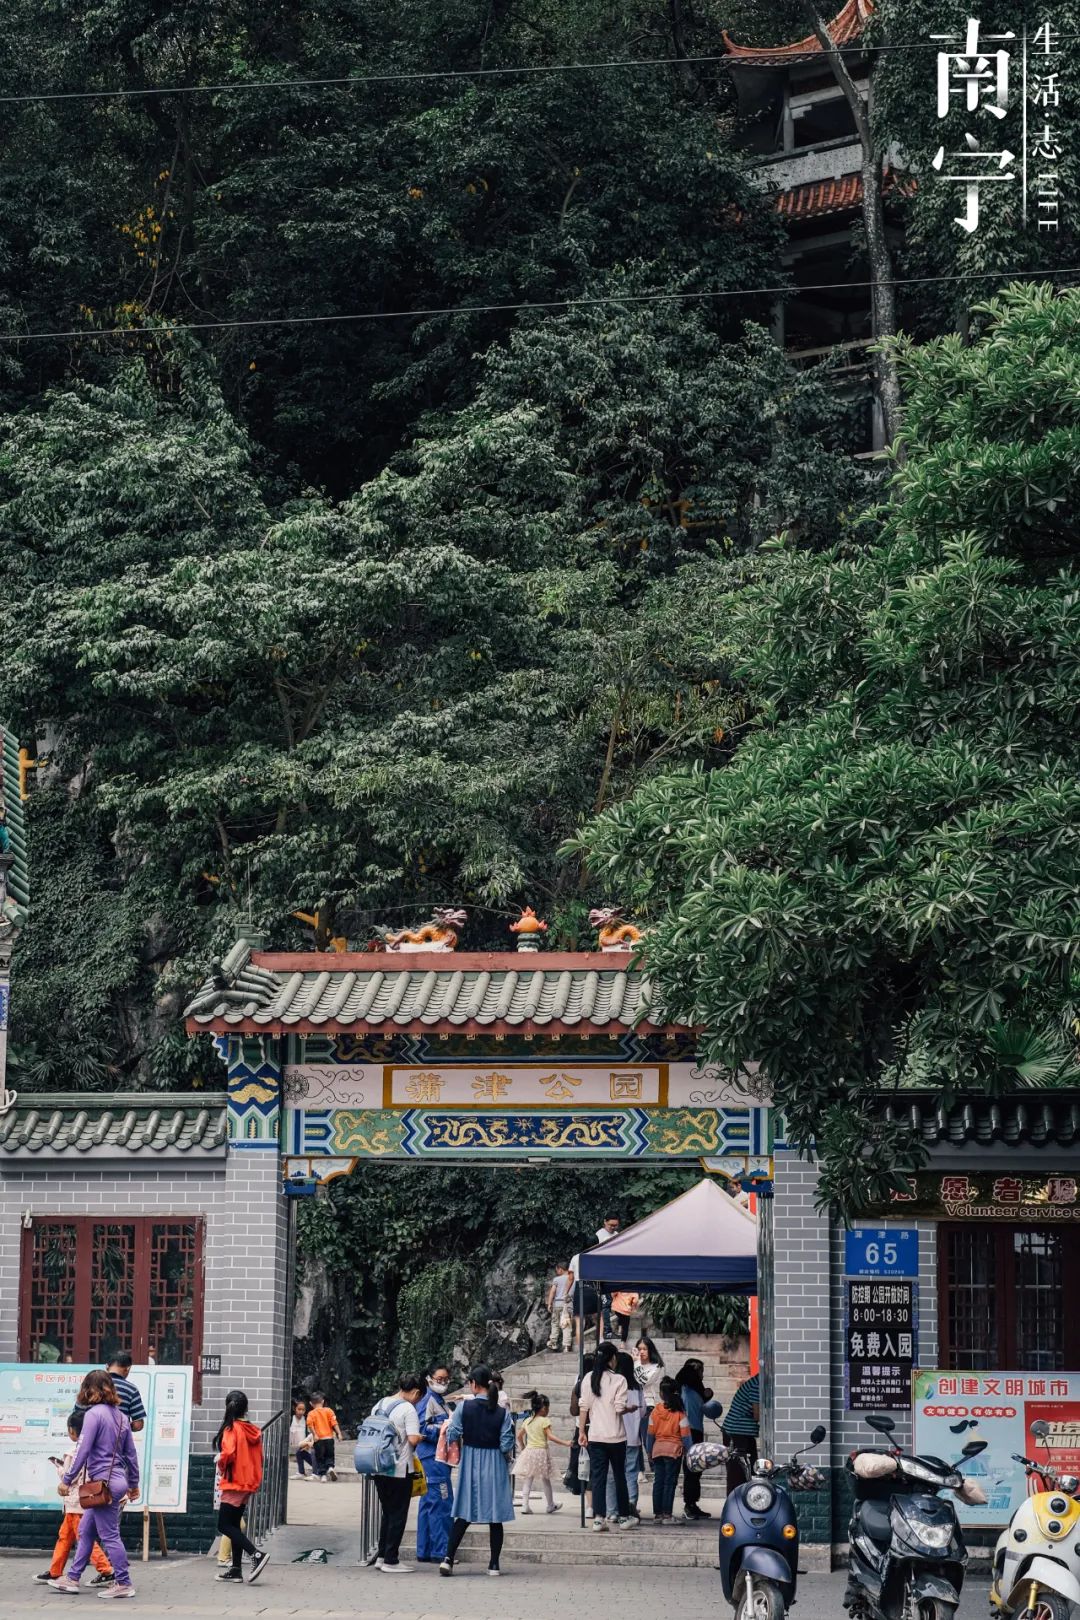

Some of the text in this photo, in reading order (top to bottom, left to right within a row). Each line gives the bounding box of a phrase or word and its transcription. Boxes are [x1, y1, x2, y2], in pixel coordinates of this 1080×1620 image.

[945, 1203, 1017, 1217] Volunteer
[1019, 1204, 1071, 1218] service
[865, 1242, 898, 1265] 65
[850, 1331, 912, 1358] 免费入园
[938, 1377, 1069, 1397] 创建文明城市
